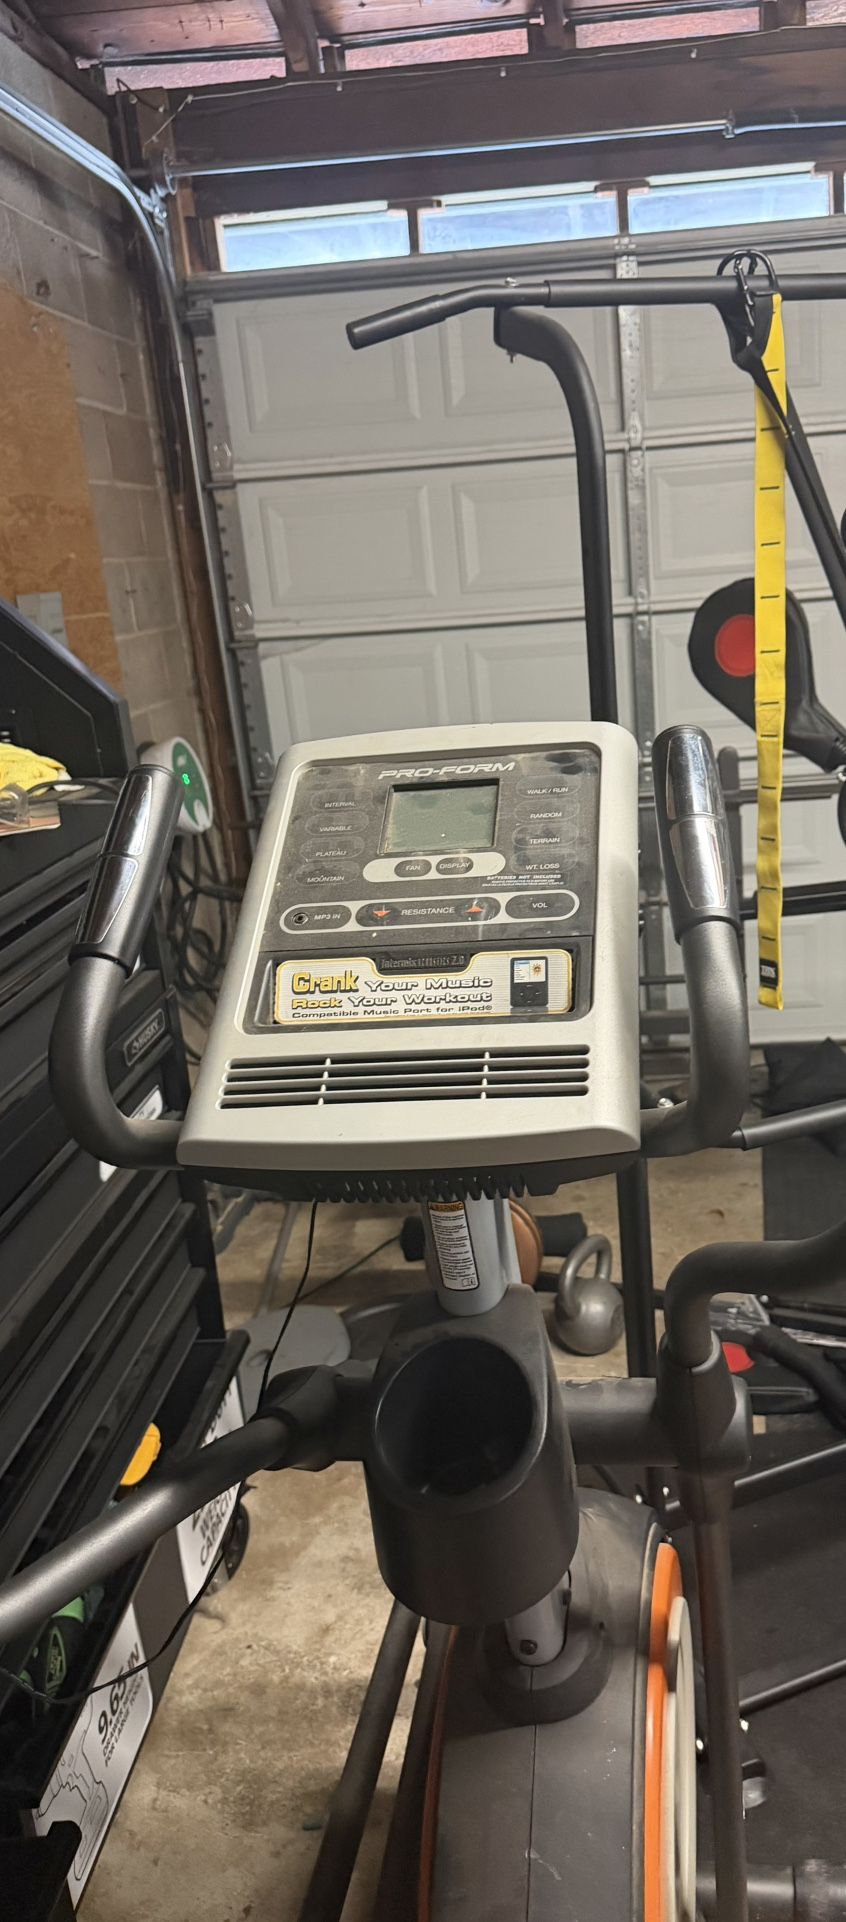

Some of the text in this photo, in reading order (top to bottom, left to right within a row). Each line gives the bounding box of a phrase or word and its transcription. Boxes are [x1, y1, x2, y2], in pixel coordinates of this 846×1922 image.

[378, 762, 515, 780] PRO-FORM
[529, 811, 562, 819] RANDOM
[529, 837, 560, 845] TERRAIN
[401, 907, 456, 916] RESISTANCE
[292, 970, 492, 995] Crank Your Music
[292, 992, 492, 1009] Rock Your Workout
[292, 1011, 359, 1019] Compatible
[363, 1008, 399, 1016] Music
